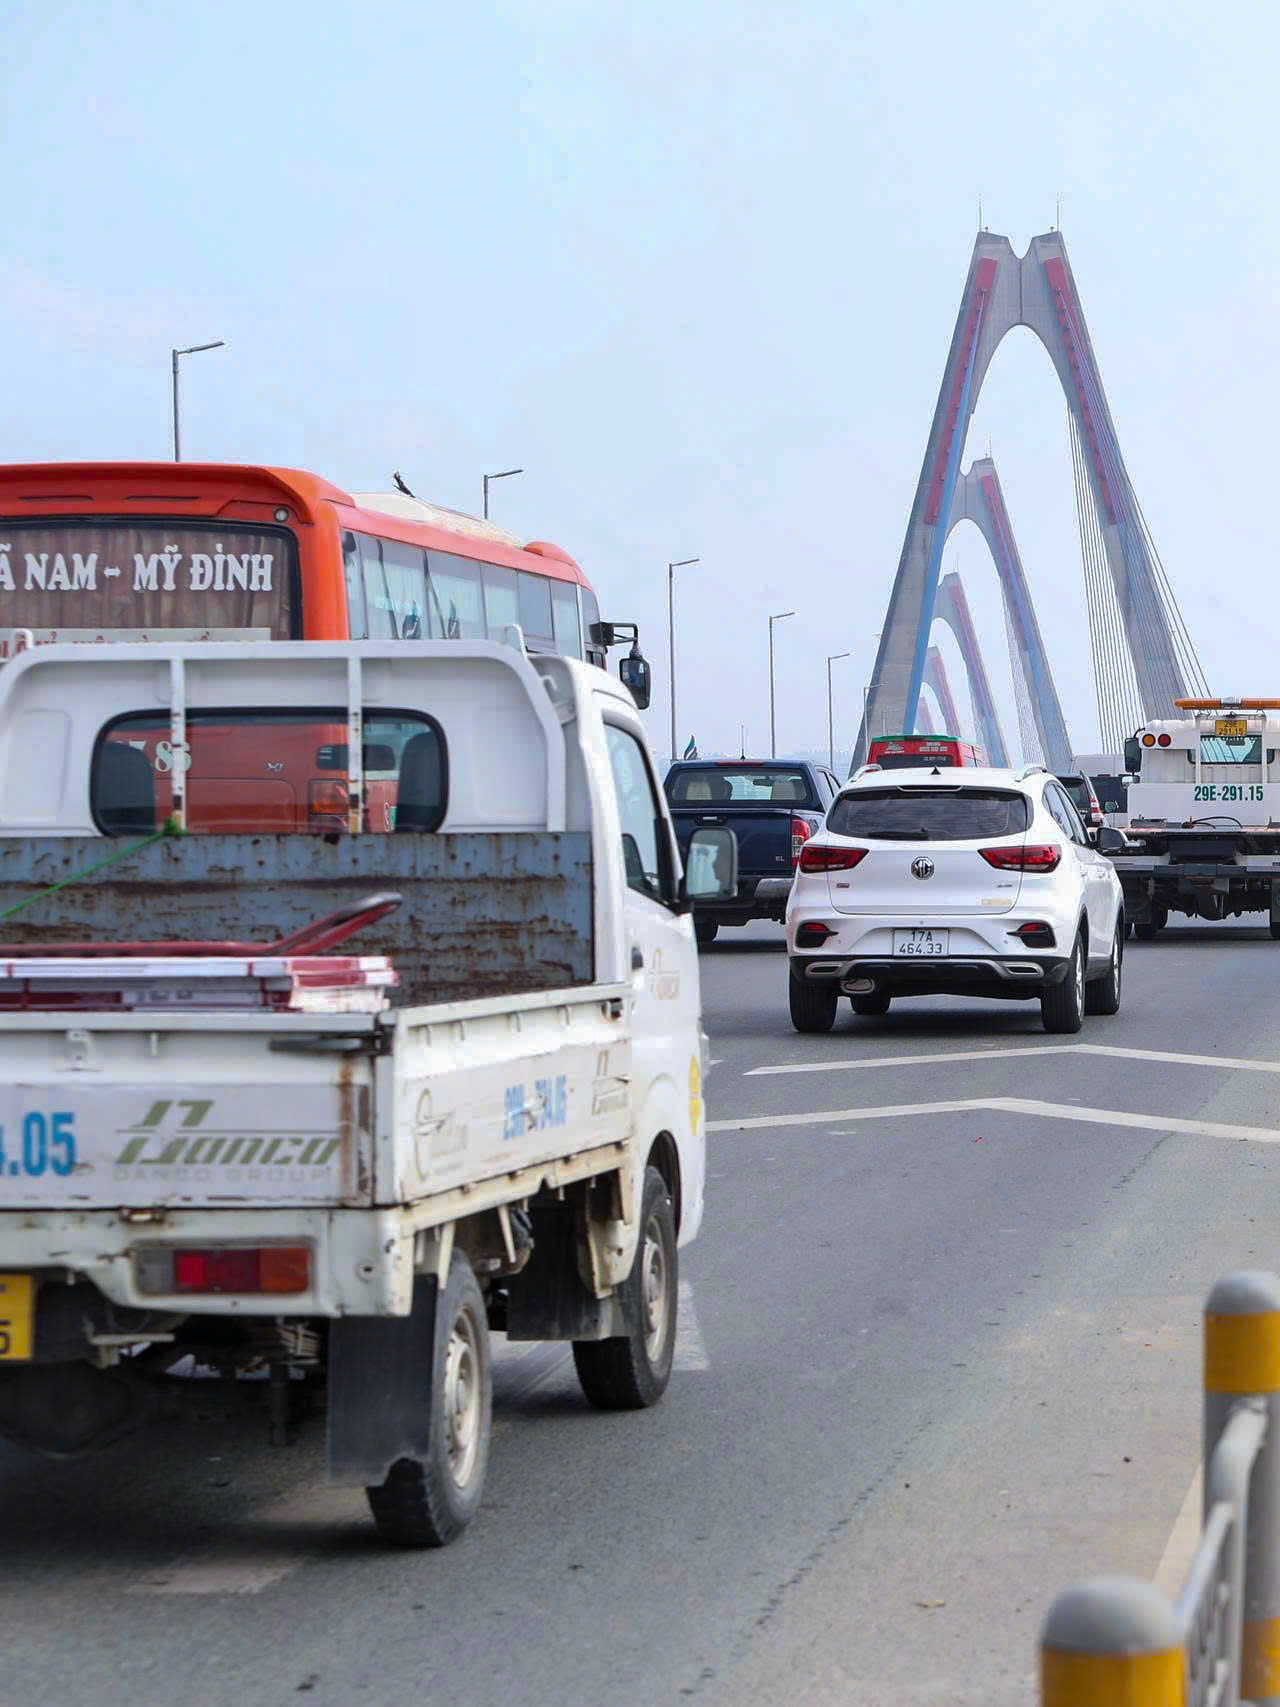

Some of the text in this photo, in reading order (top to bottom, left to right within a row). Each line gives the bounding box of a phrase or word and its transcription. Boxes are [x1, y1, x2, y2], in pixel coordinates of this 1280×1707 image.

[24, 553, 98, 590] NAM
[133, 544, 182, 590] MỸ
[1194, 785, 1264, 801] 29E-291.15
[911, 930, 933, 942] 17A
[899, 943, 943, 954] 464.33
[0, 1111, 76, 1177] .05
[113, 1167, 330, 1183] DANCO GROUP
